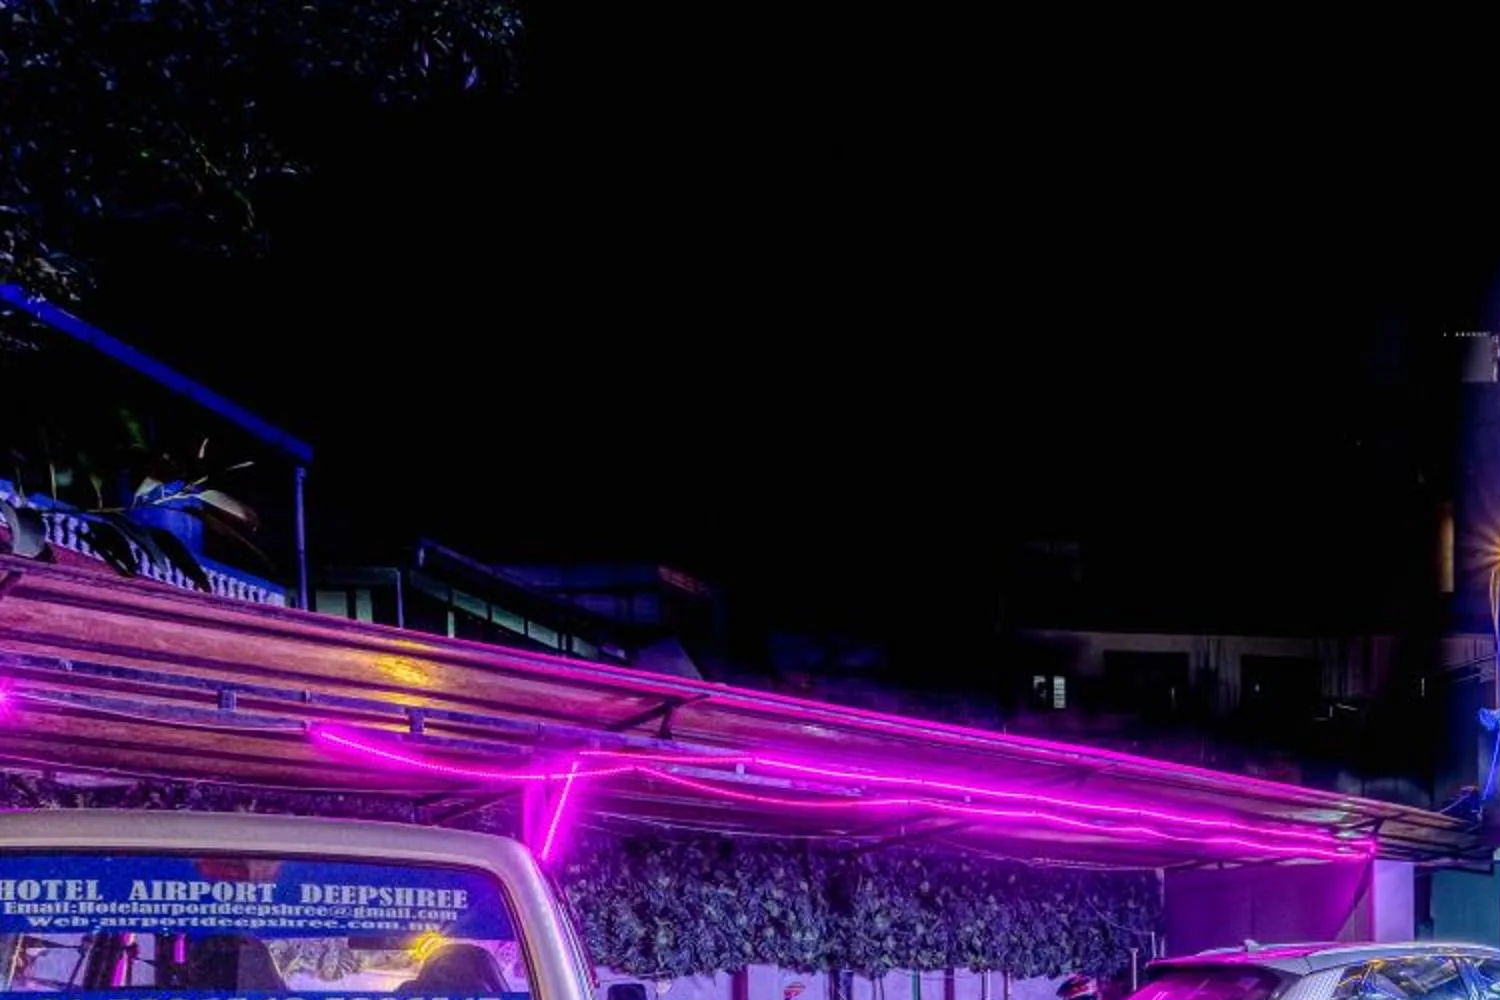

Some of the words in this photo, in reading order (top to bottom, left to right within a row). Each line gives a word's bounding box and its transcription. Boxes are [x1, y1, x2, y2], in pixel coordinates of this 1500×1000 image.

[0, 879, 103, 901] HOTEL
[128, 880, 276, 903] AIRPORT
[300, 883, 467, 909] DEEPSHREE
